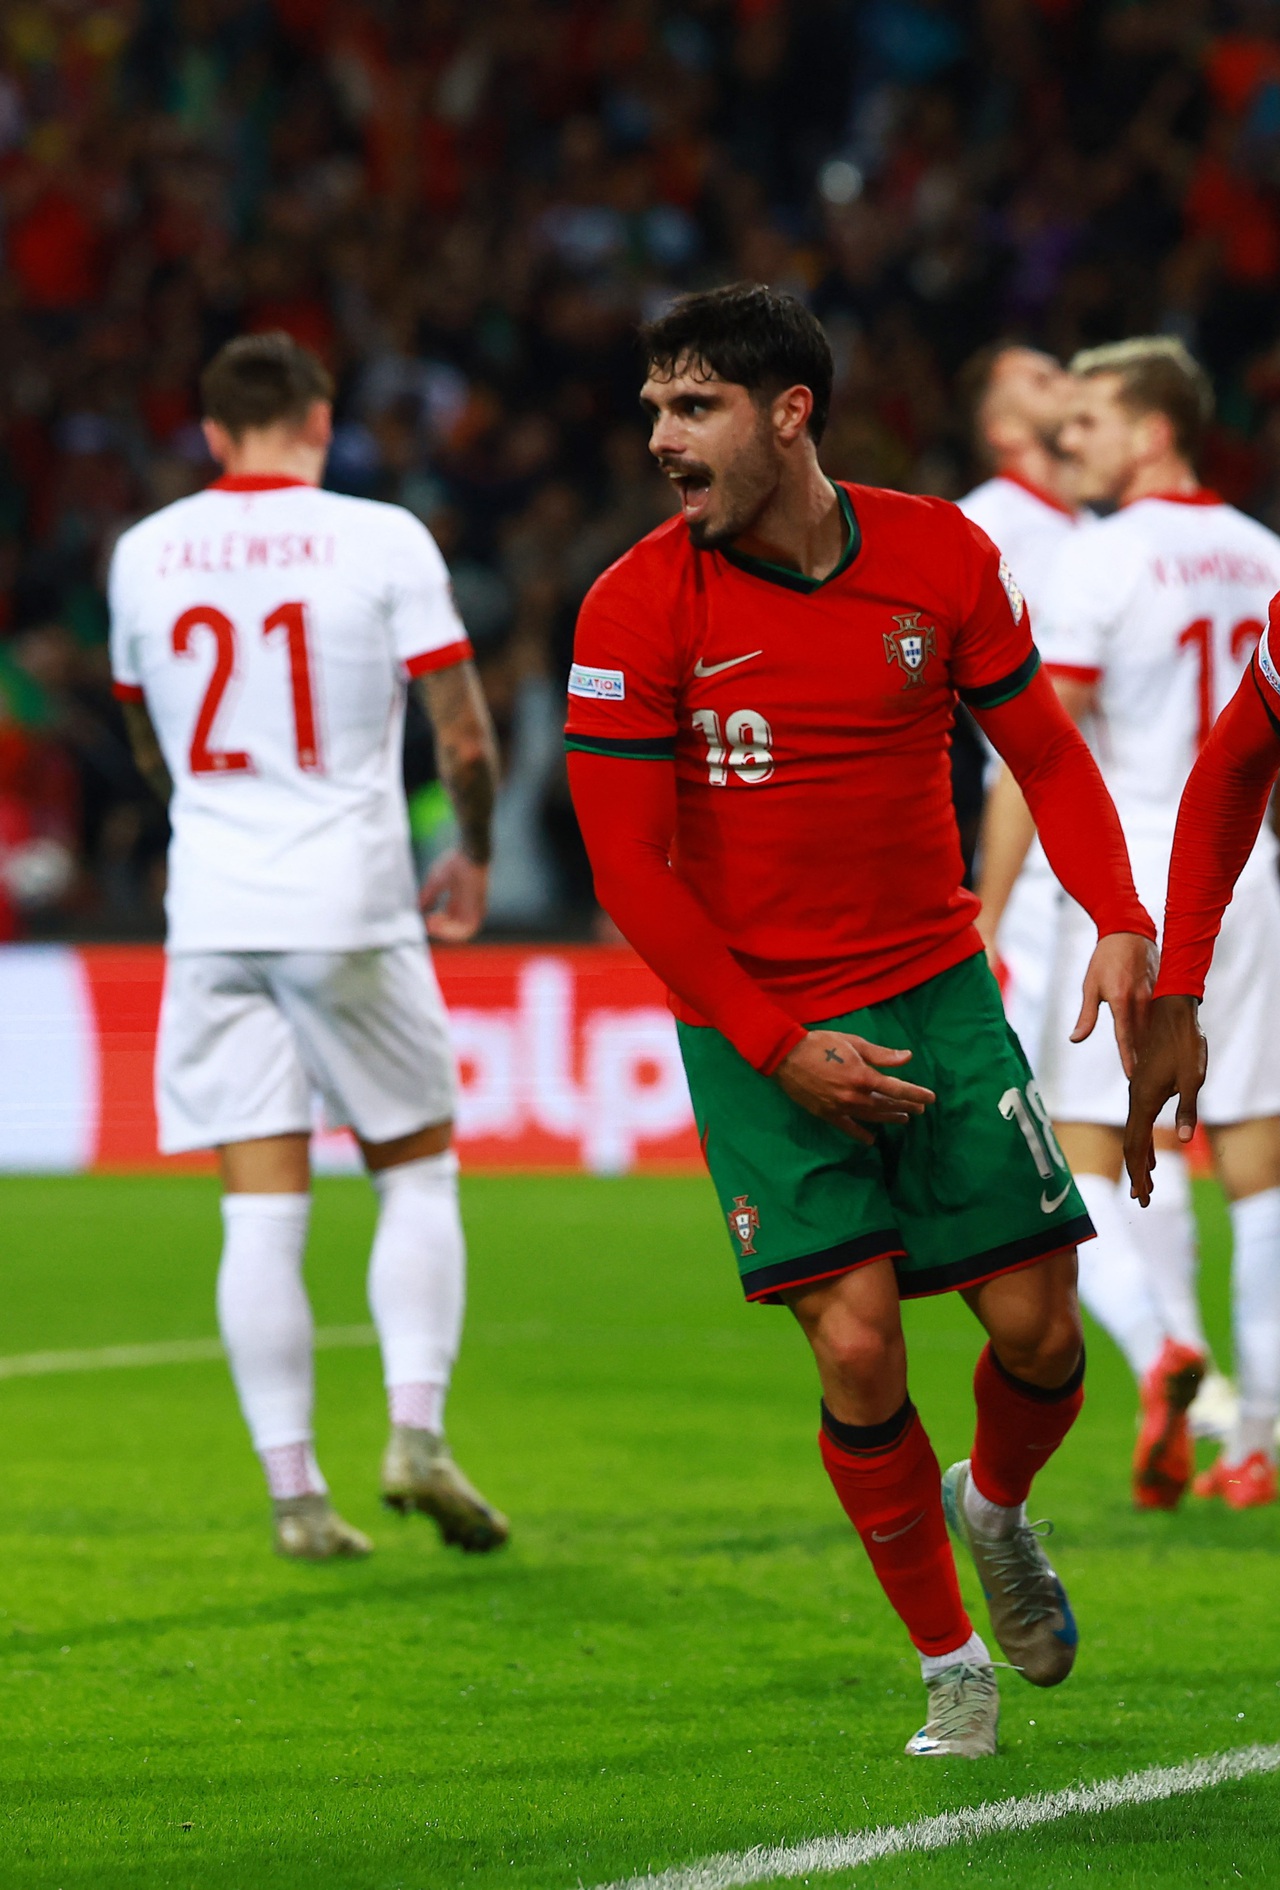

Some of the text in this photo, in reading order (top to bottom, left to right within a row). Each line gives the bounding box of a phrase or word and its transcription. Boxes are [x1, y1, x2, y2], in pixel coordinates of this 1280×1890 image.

[157, 531, 337, 578] ZALEWSKI
[170, 601, 324, 776] 21
[692, 709, 775, 786] 18
[312, 960, 696, 1175] alp
